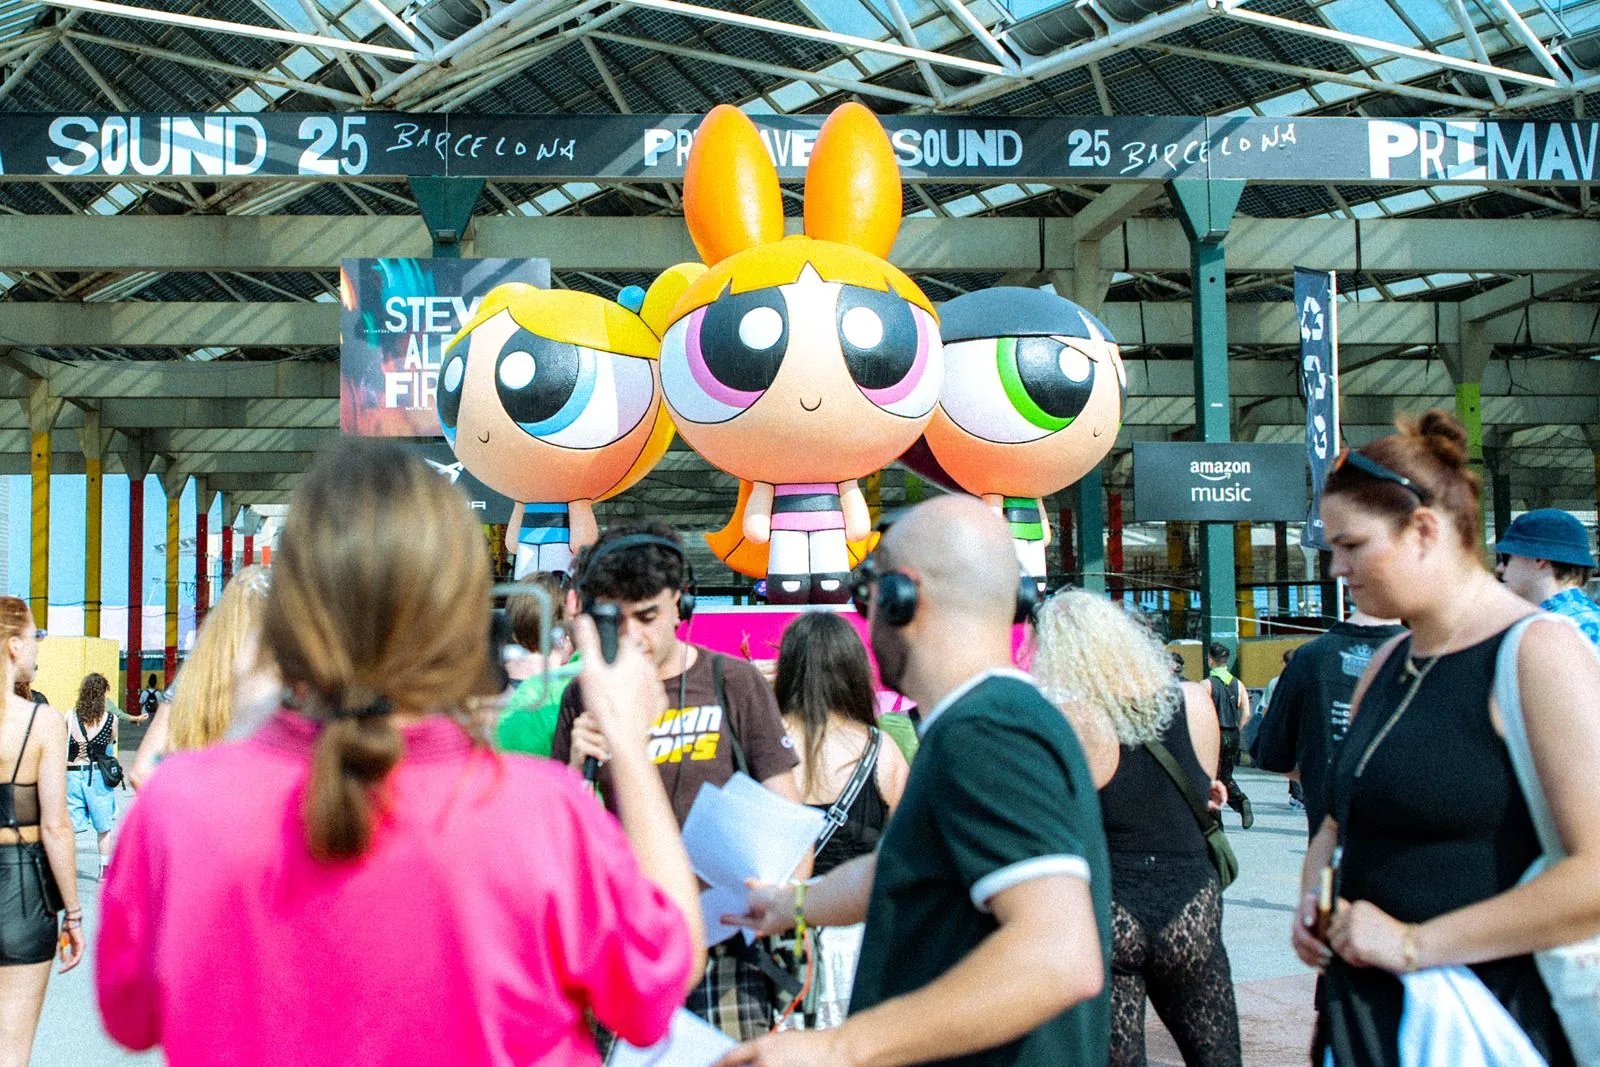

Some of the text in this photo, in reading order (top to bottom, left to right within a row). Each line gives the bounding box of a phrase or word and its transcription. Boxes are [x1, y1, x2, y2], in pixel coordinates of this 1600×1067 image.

[46, 116, 268, 176] SOUND
[298, 116, 367, 176] 25
[386, 122, 576, 161] BARCELONA
[891, 128, 1023, 167] SOUND
[1067, 128, 1111, 167] 25
[1120, 123, 1297, 174] BARCELONA
[1367, 120, 1599, 181] PRIMAV
[1190, 461, 1251, 475] amazon
[1191, 483, 1252, 502] music
